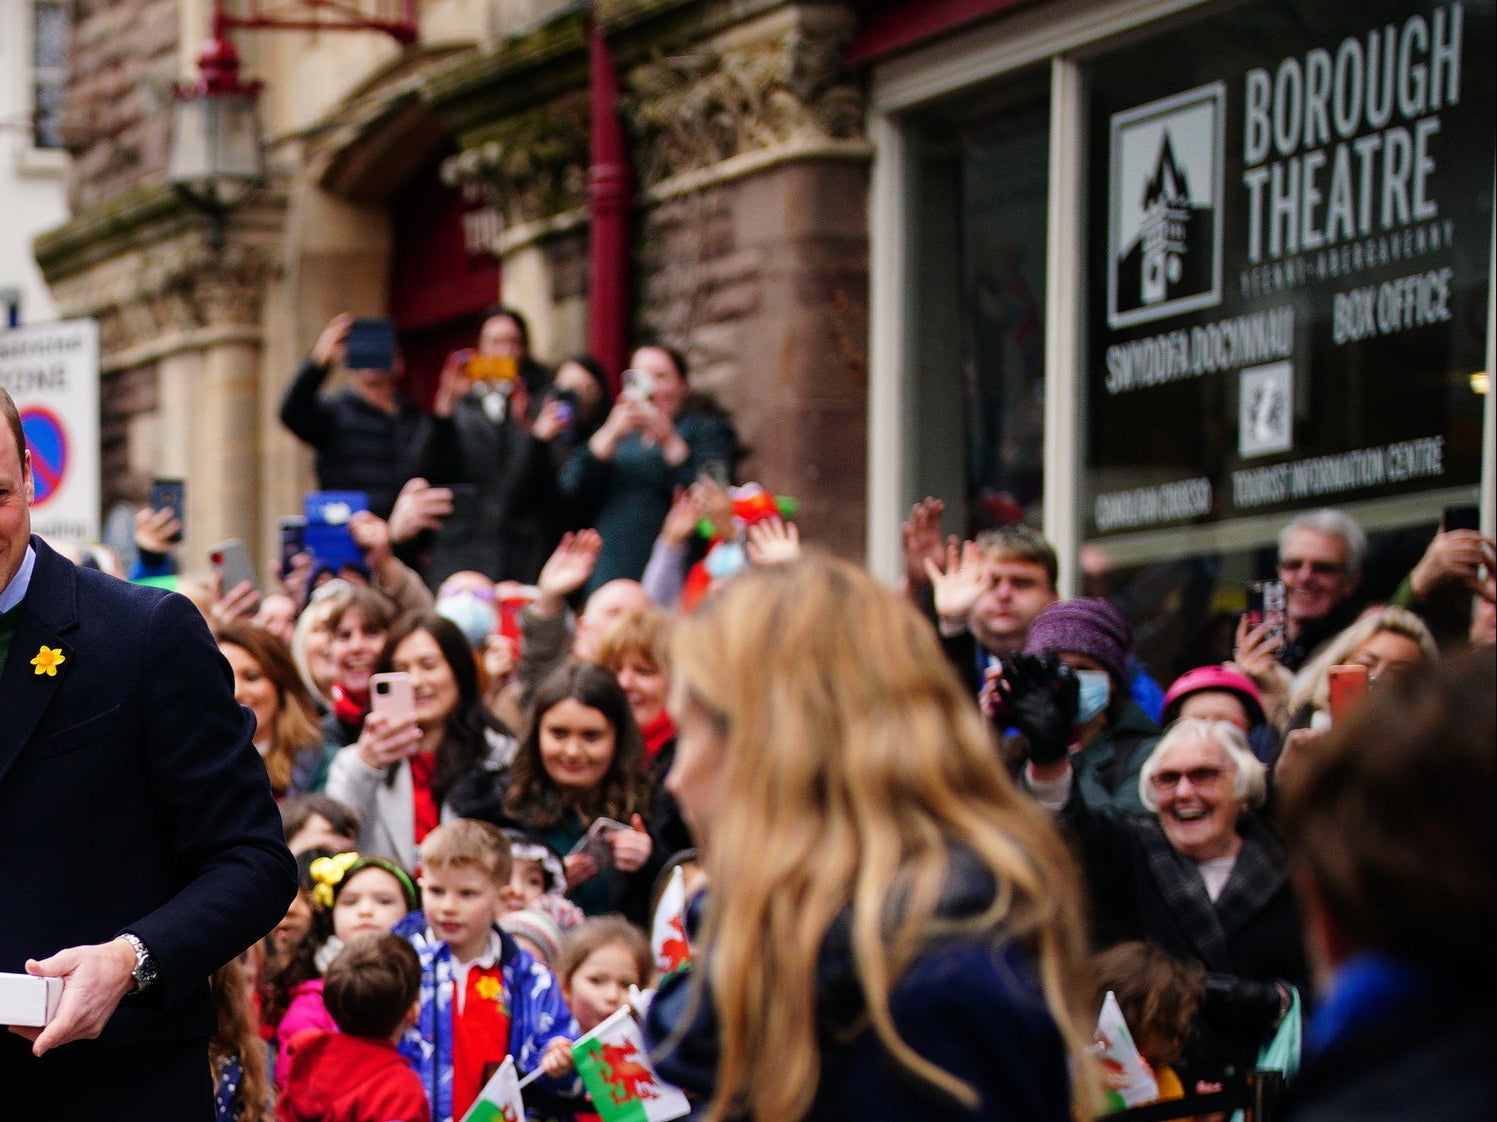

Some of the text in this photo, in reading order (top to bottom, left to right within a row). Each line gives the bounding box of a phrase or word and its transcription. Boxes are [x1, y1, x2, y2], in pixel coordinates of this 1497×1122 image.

[1244, 2, 1464, 166] BOROUGH
[1243, 115, 1441, 265] THEATRE
[1333, 266, 1453, 346] BOX OFFICE
